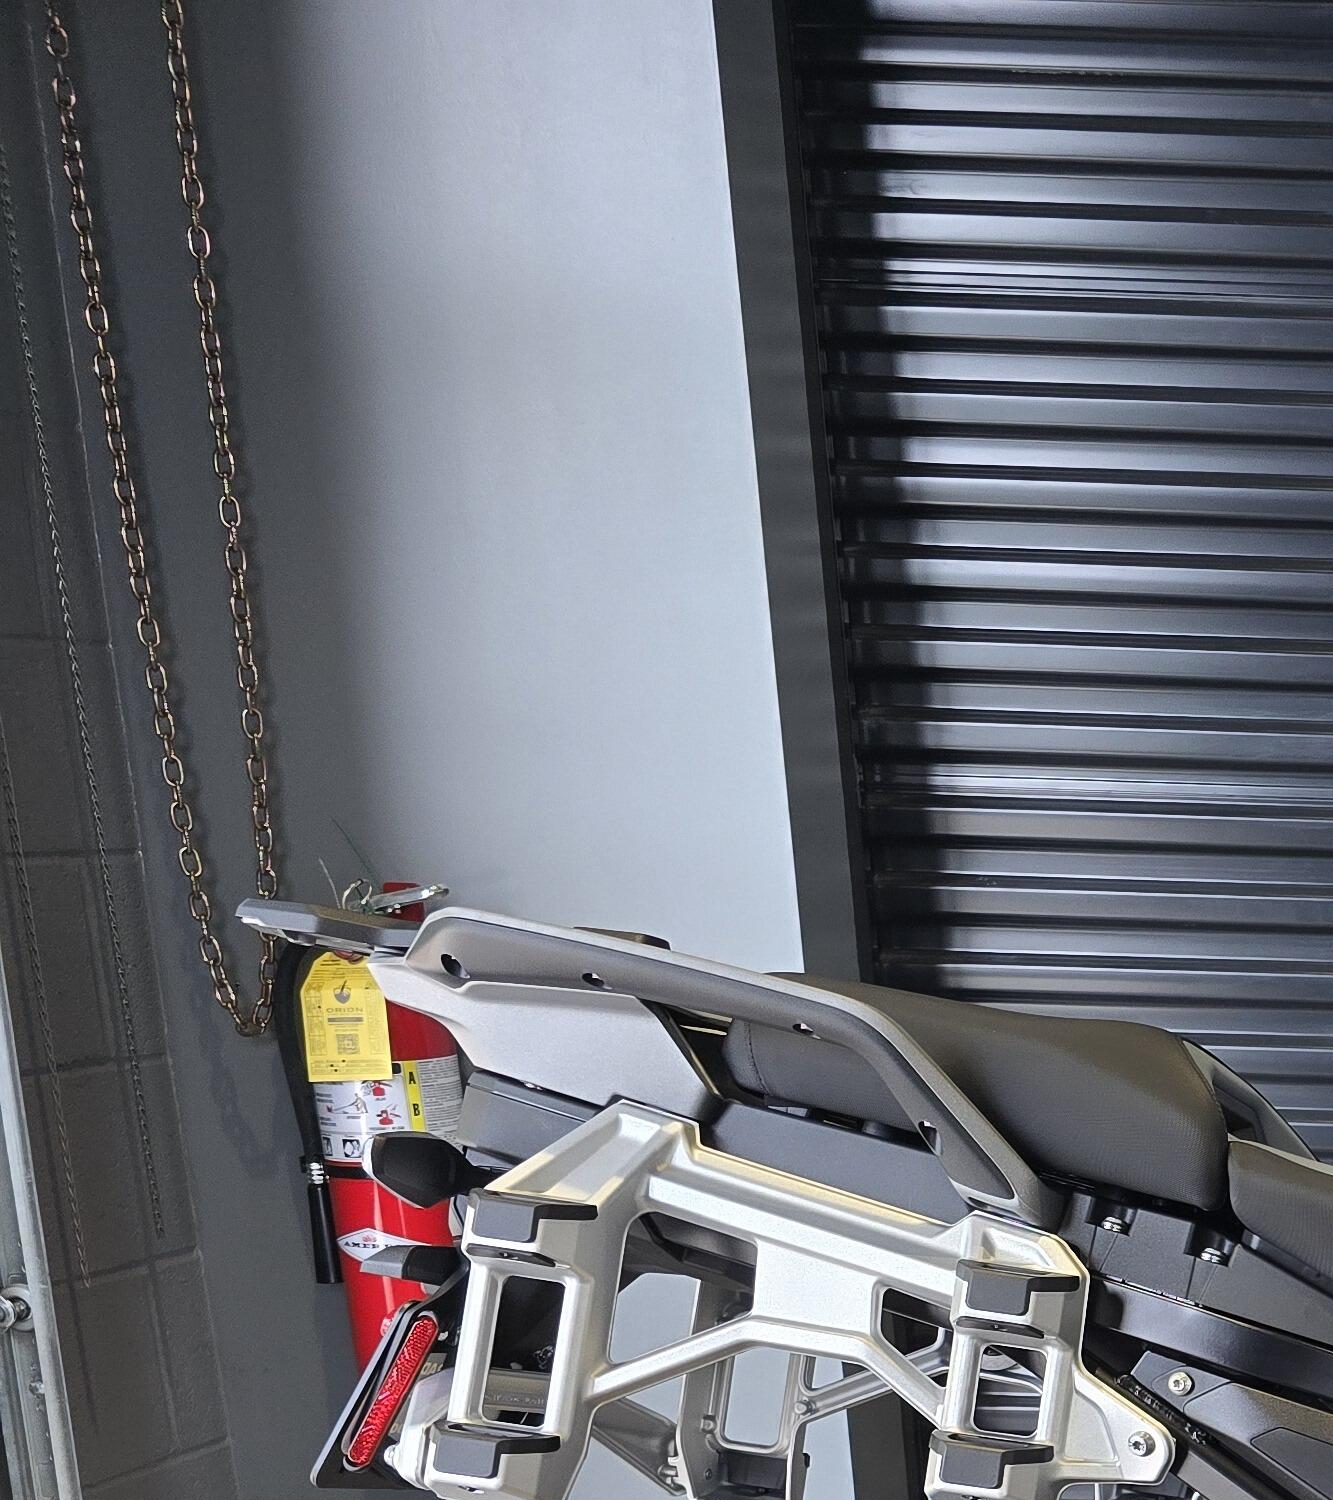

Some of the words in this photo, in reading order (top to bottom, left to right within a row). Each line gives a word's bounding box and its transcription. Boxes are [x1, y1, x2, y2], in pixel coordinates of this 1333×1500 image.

[408, 1071, 416, 1085] A
[412, 1103, 420, 1117] B
[343, 1240, 392, 1249] AMER
